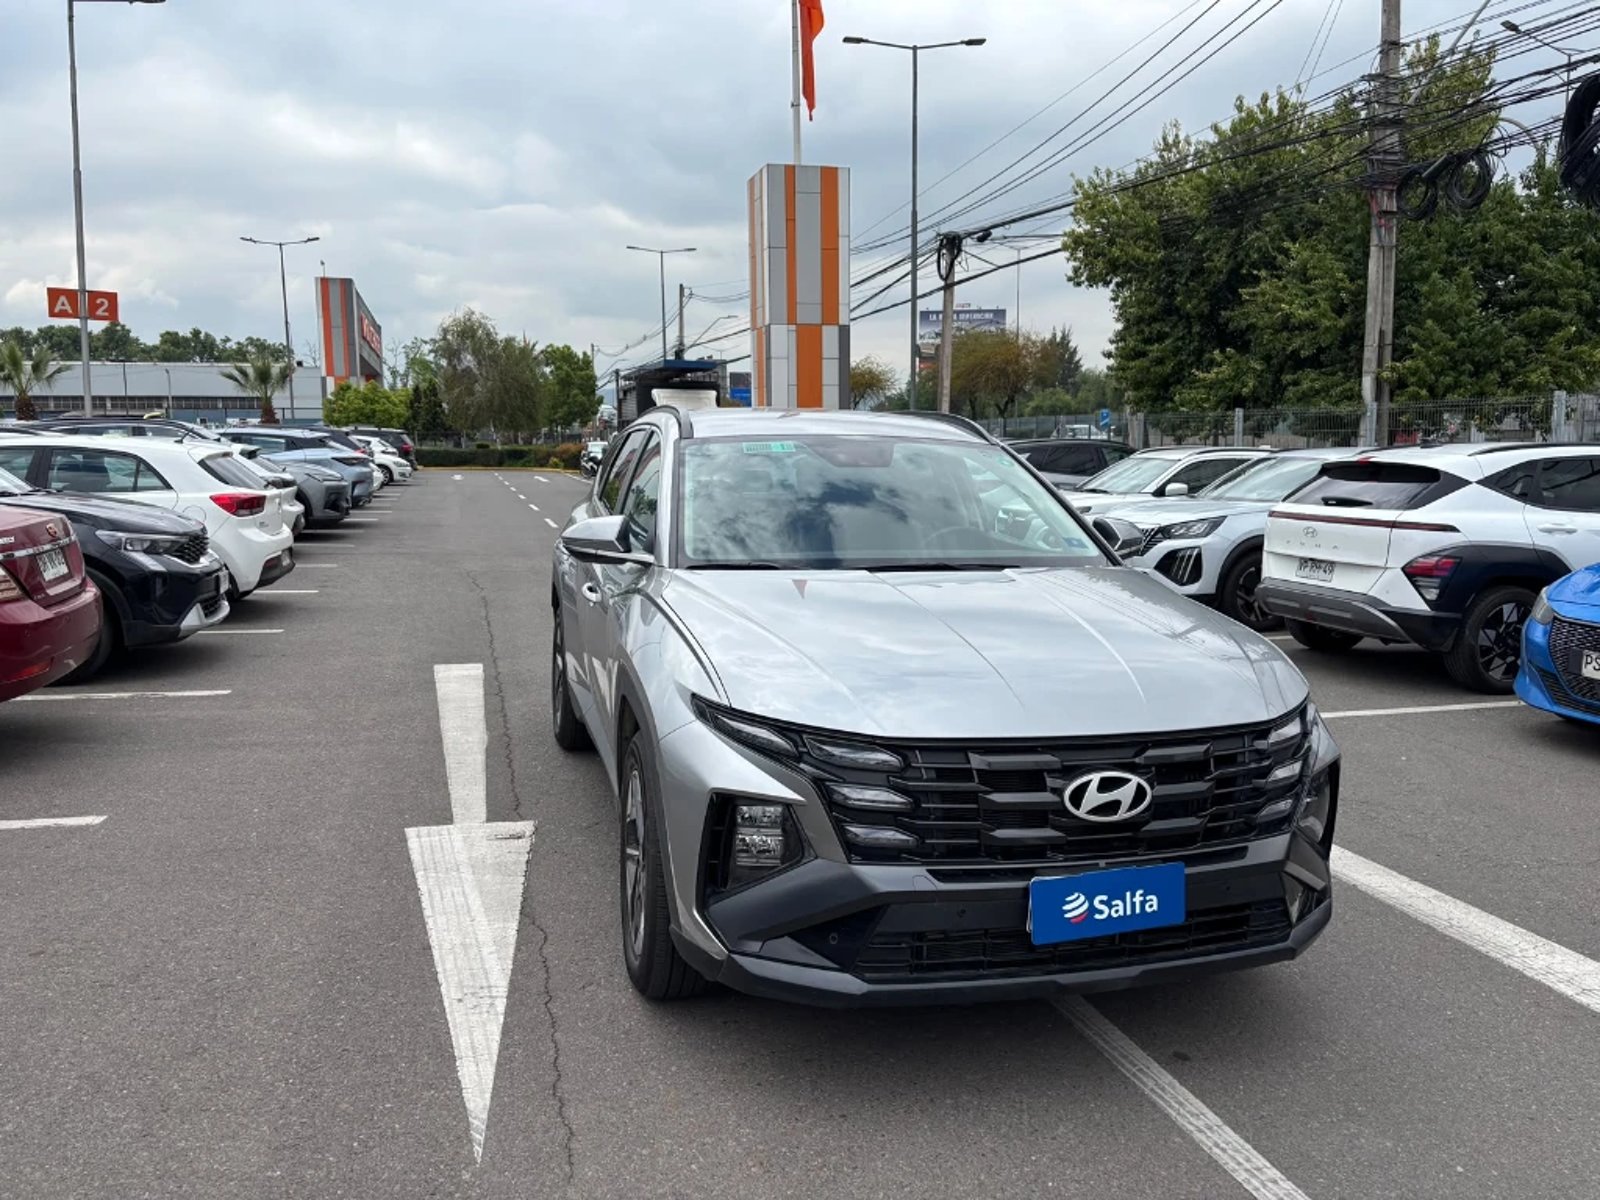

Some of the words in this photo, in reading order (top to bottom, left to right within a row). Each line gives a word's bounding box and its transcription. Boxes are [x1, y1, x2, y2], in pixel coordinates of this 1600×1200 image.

[54, 295, 73, 314] A
[95, 297, 109, 316] 2
[1093, 889, 1158, 920] Salfa
